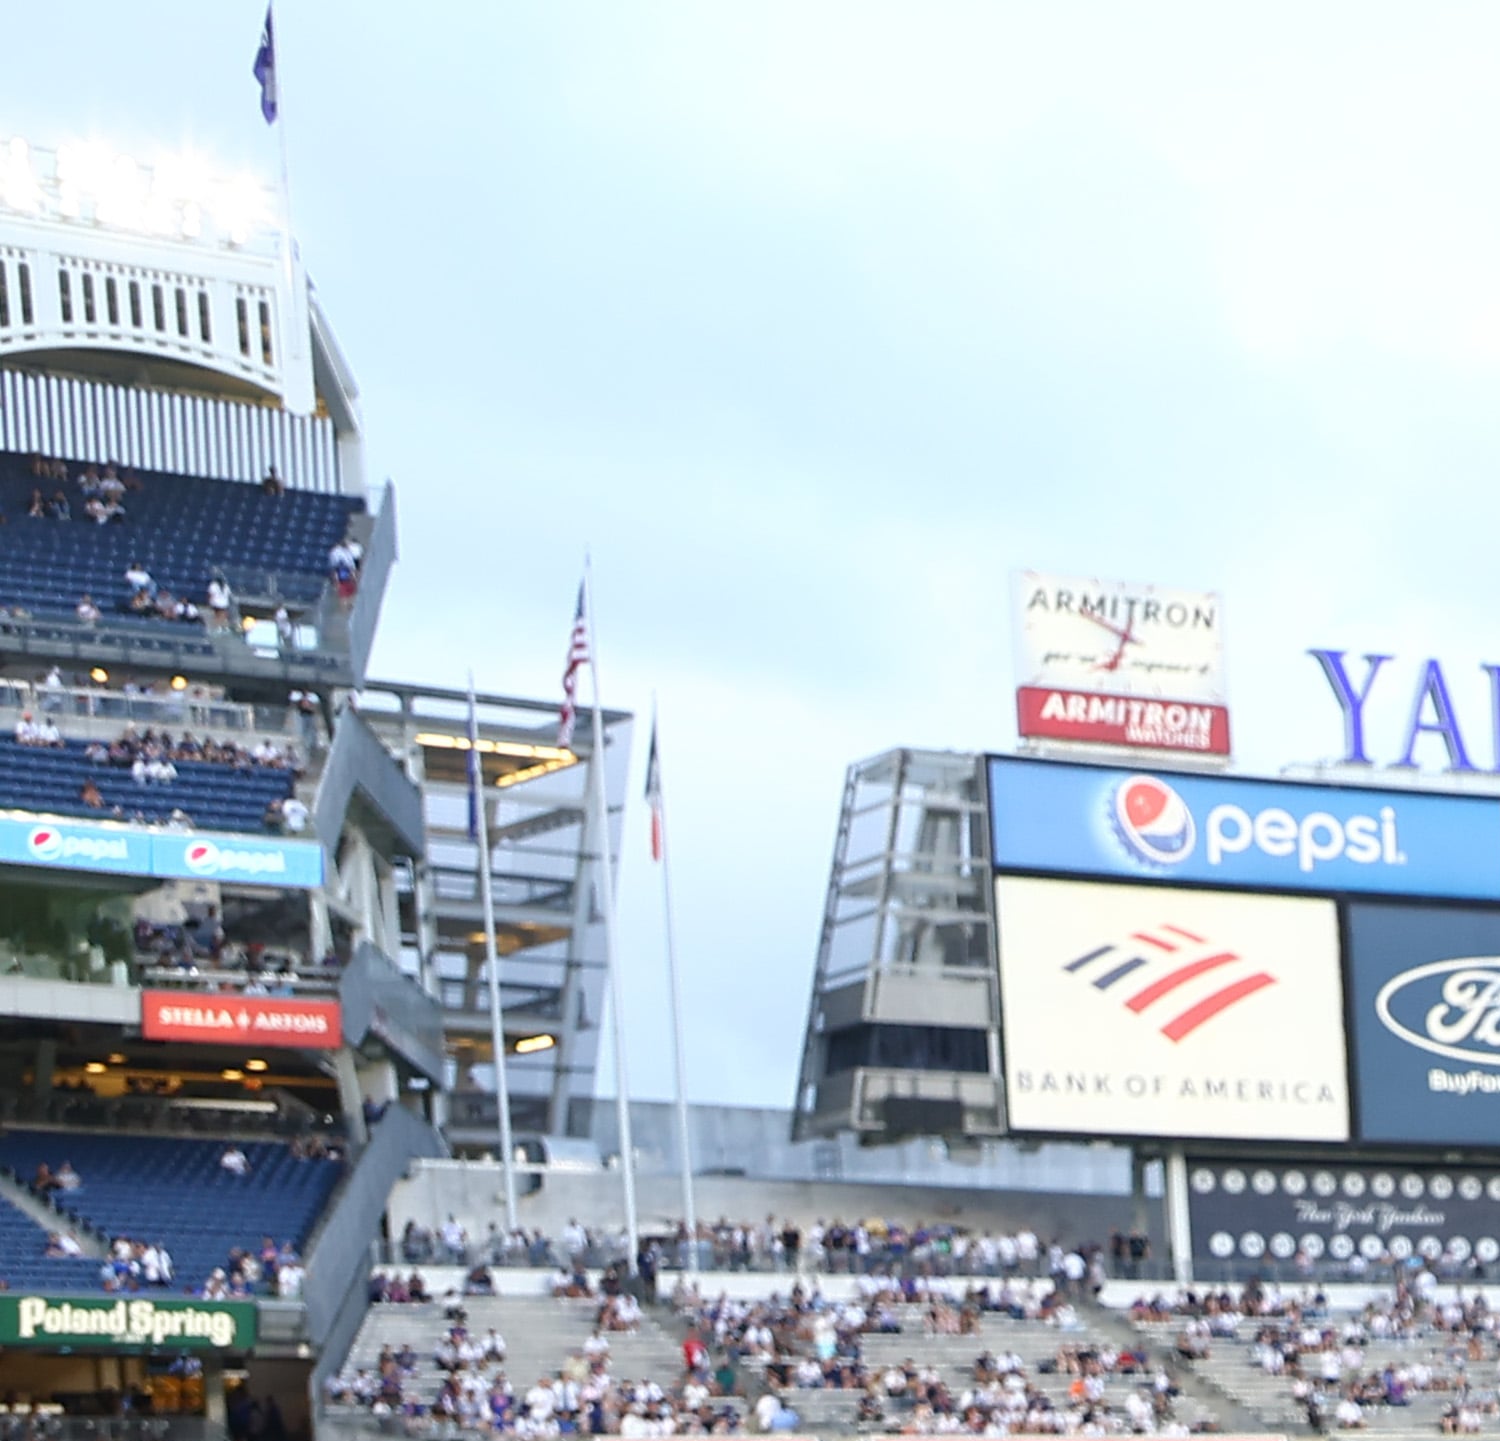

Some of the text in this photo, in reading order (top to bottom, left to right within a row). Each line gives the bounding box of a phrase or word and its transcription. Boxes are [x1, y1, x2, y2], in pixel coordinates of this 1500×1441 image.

[1027, 587, 1214, 629] ARMITRON
[1040, 691, 1212, 731] ARMITRON
[158, 1006, 233, 1028] STELLA
[1016, 1069, 1336, 1105] BANK OF AMERICA
[18, 1297, 236, 1346] Poland Spring
